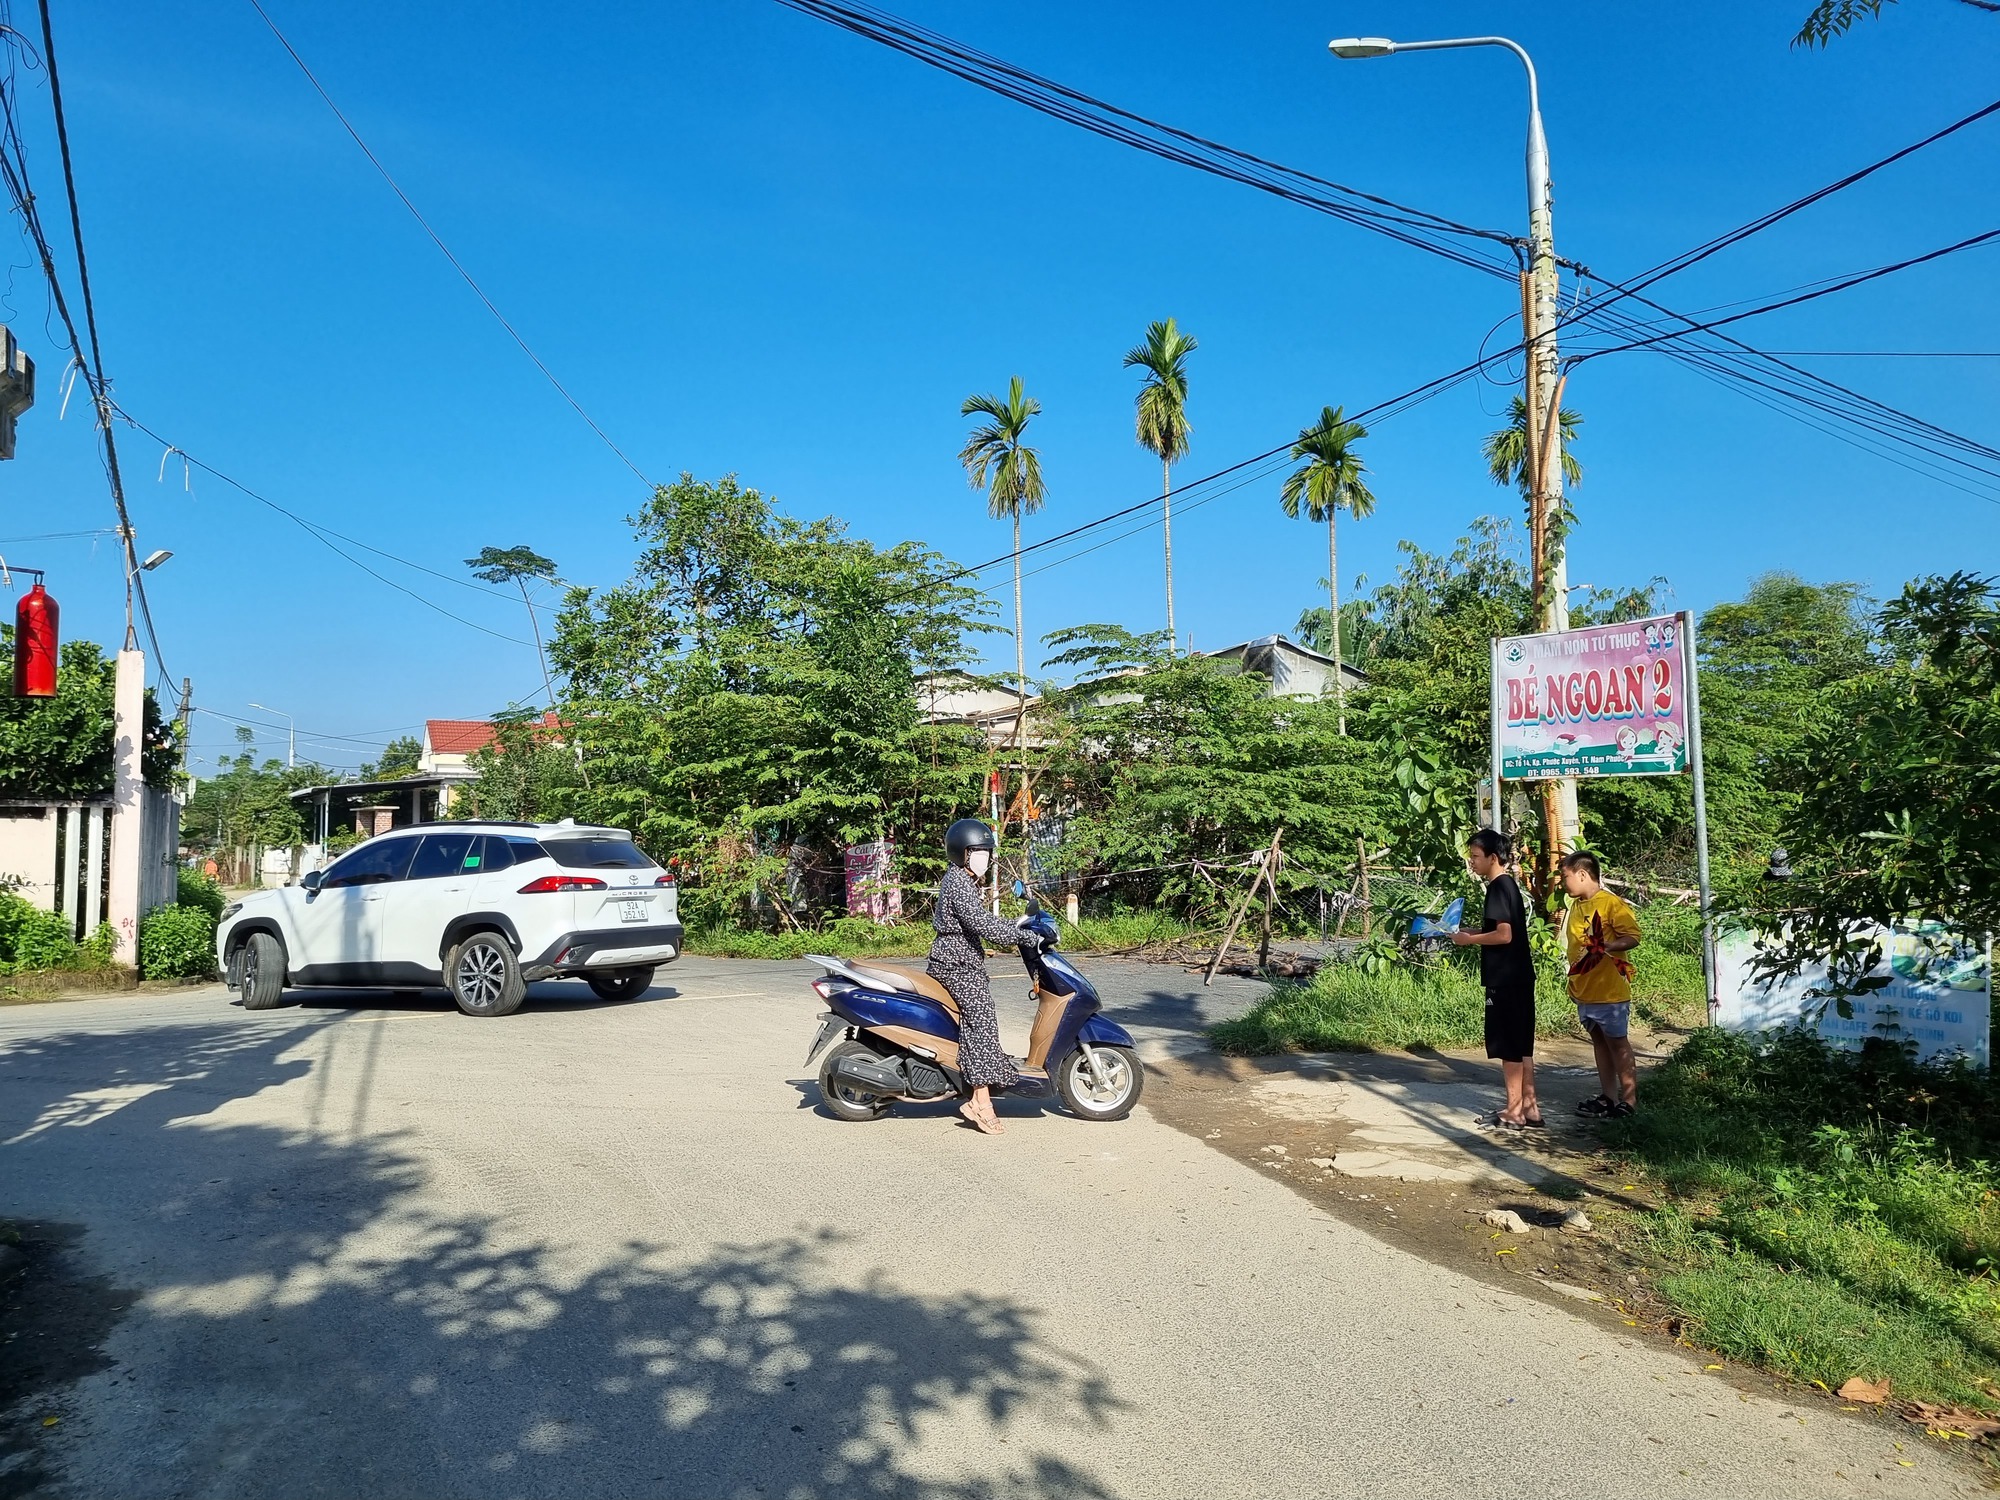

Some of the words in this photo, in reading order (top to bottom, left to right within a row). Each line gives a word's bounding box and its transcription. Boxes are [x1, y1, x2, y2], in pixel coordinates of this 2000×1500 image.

[1564, 638, 1589, 655] NON
[1591, 634, 1607, 652] TƯ
[1608, 631, 1641, 651] THỤC
[1507, 664, 1540, 724] BÉ
[1546, 663, 1646, 723] NGOAN
[1653, 658, 1673, 719] 2
[1591, 755, 1605, 764] Nam
[1583, 766, 1600, 775] 548
[627, 901, 639, 910] 92A
[1842, 1020, 1868, 1033] CAFE
